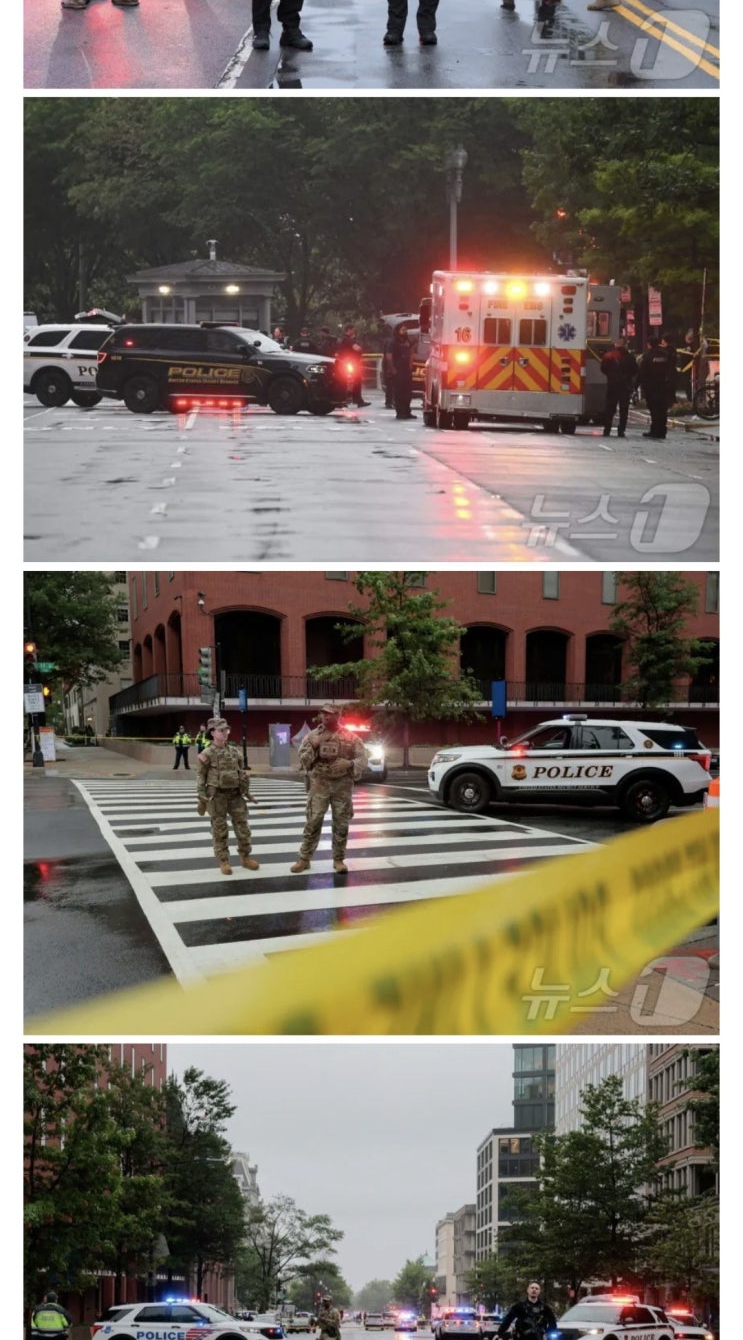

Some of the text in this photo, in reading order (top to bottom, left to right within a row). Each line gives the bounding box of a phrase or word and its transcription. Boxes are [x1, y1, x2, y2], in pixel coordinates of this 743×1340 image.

[455, 326, 472, 342] 16
[168, 366, 241, 378] POLICE
[532, 765, 614, 779] POLICE
[136, 1331, 185, 1340] POLICE
